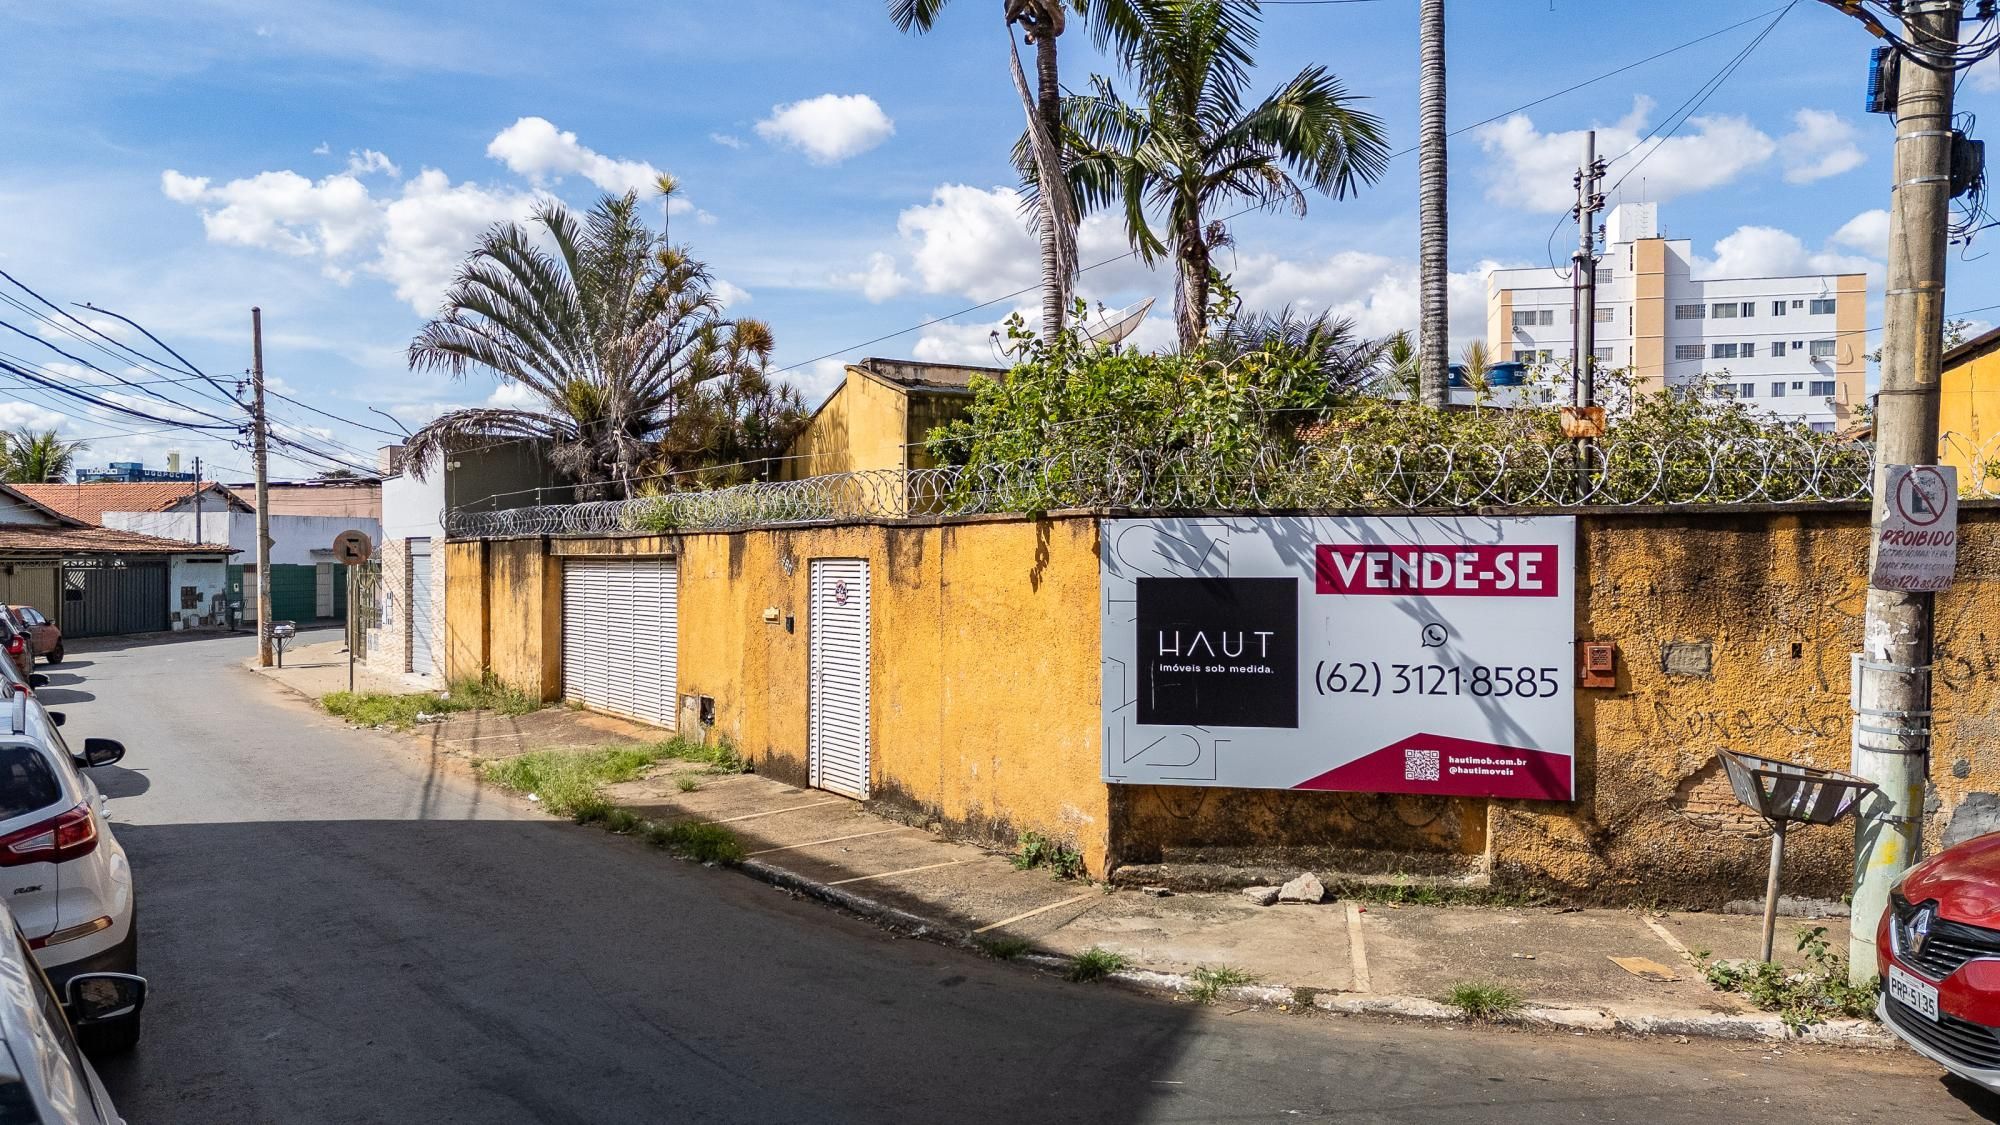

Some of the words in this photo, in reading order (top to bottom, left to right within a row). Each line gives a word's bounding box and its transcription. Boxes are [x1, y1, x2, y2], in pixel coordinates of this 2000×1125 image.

[1881, 529, 1955, 547] PROIBIDO
[1331, 551, 1543, 590] VENDE-SE
[1160, 630, 1275, 658] HAUT
[1205, 664, 1225, 673] sob
[1229, 665, 1275, 674] medida.
[1315, 660, 1381, 697] (62)
[1448, 755, 1527, 770] hautimob.com.br
[1449, 766, 1514, 776] @hautimoveis
